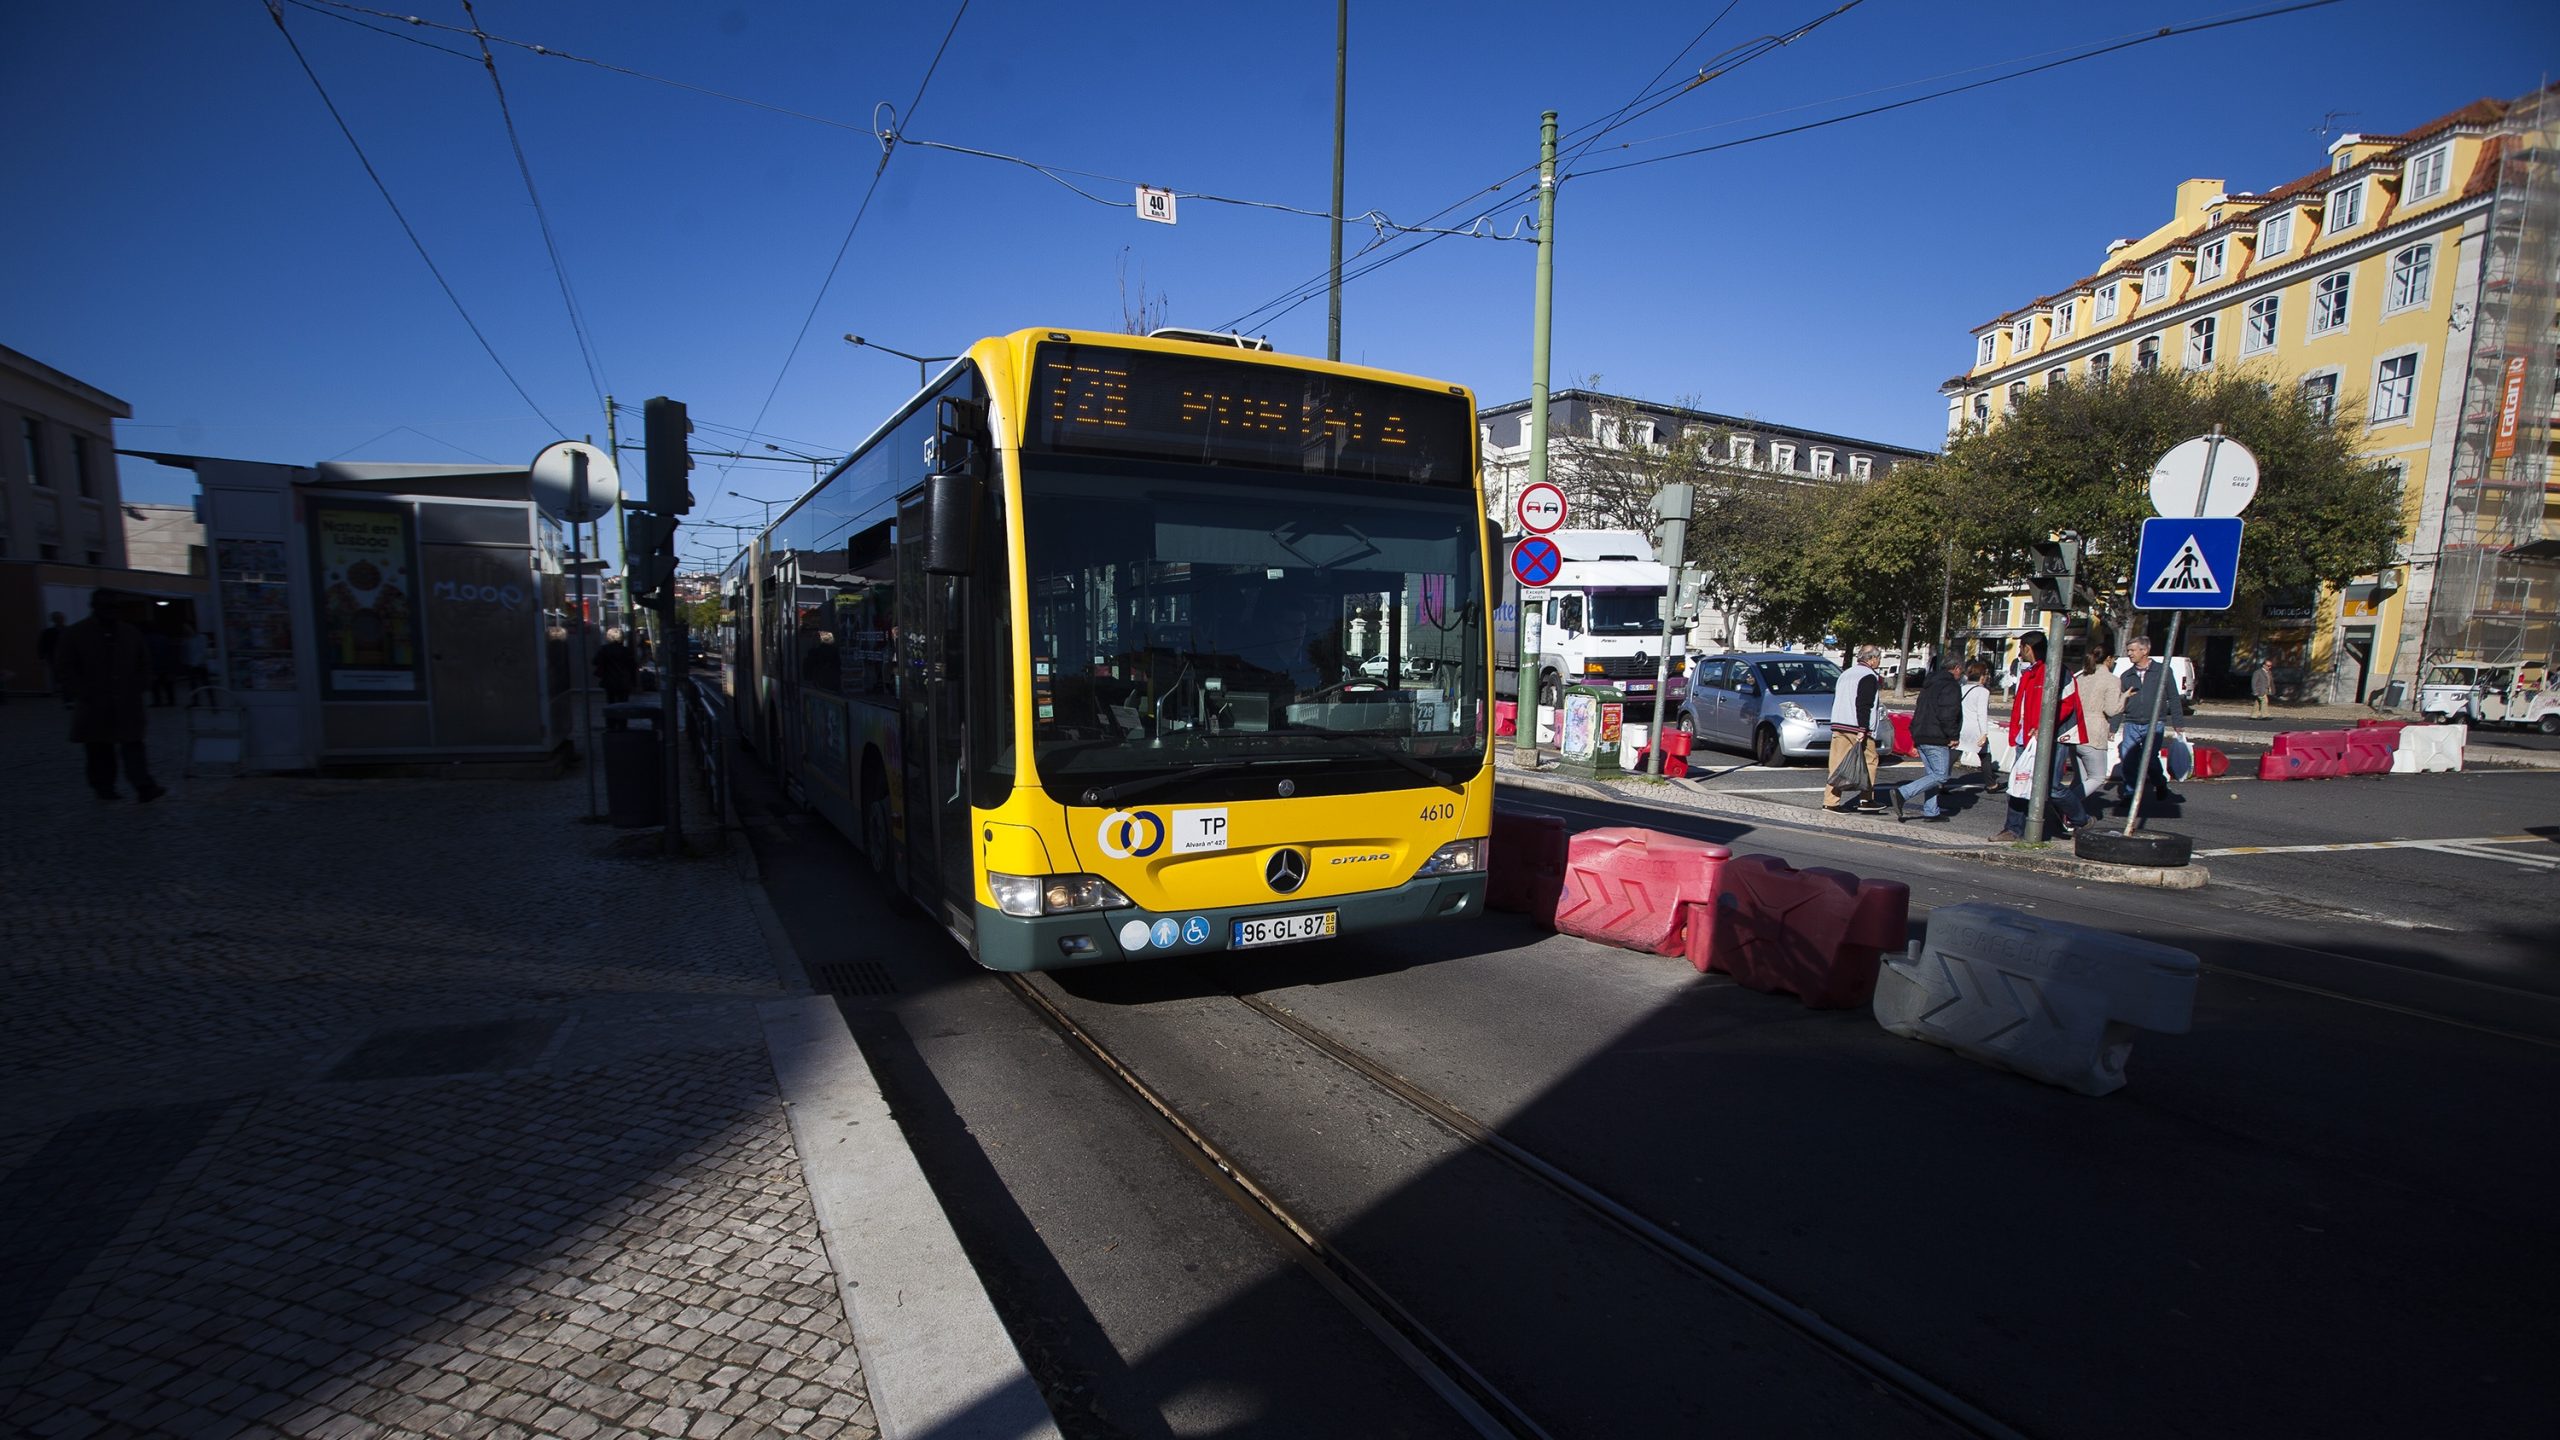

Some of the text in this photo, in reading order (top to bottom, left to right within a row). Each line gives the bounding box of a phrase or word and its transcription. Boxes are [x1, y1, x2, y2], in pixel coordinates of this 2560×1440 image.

[1150, 195, 1164, 211] 40
[322, 519, 398, 535] Natal em
[334, 533, 389, 547] Lisboa
[1417, 705, 1434, 719] 728
[1420, 803, 1454, 822] 4610
[1200, 817, 1226, 836] TP
[1330, 853, 1391, 865] CITARO
[1325, 914, 1336, 923] 08
[1325, 925, 1335, 933] 09
